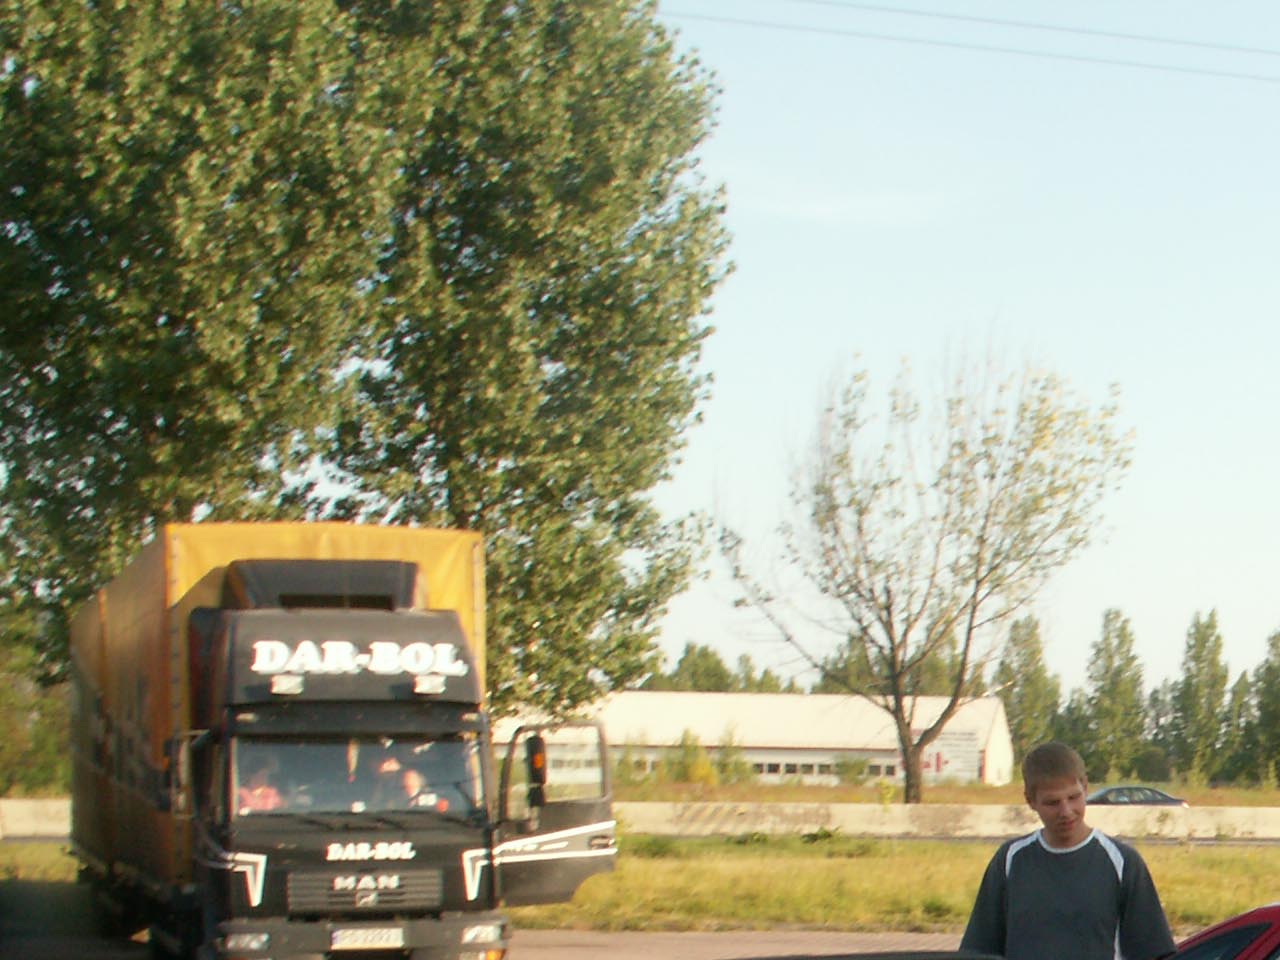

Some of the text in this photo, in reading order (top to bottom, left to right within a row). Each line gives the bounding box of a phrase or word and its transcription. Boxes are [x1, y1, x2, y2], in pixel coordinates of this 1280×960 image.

[251, 640, 469, 676] DAR-BOL
[326, 841, 416, 861] DAR-BOL
[333, 874, 400, 890] MAN
